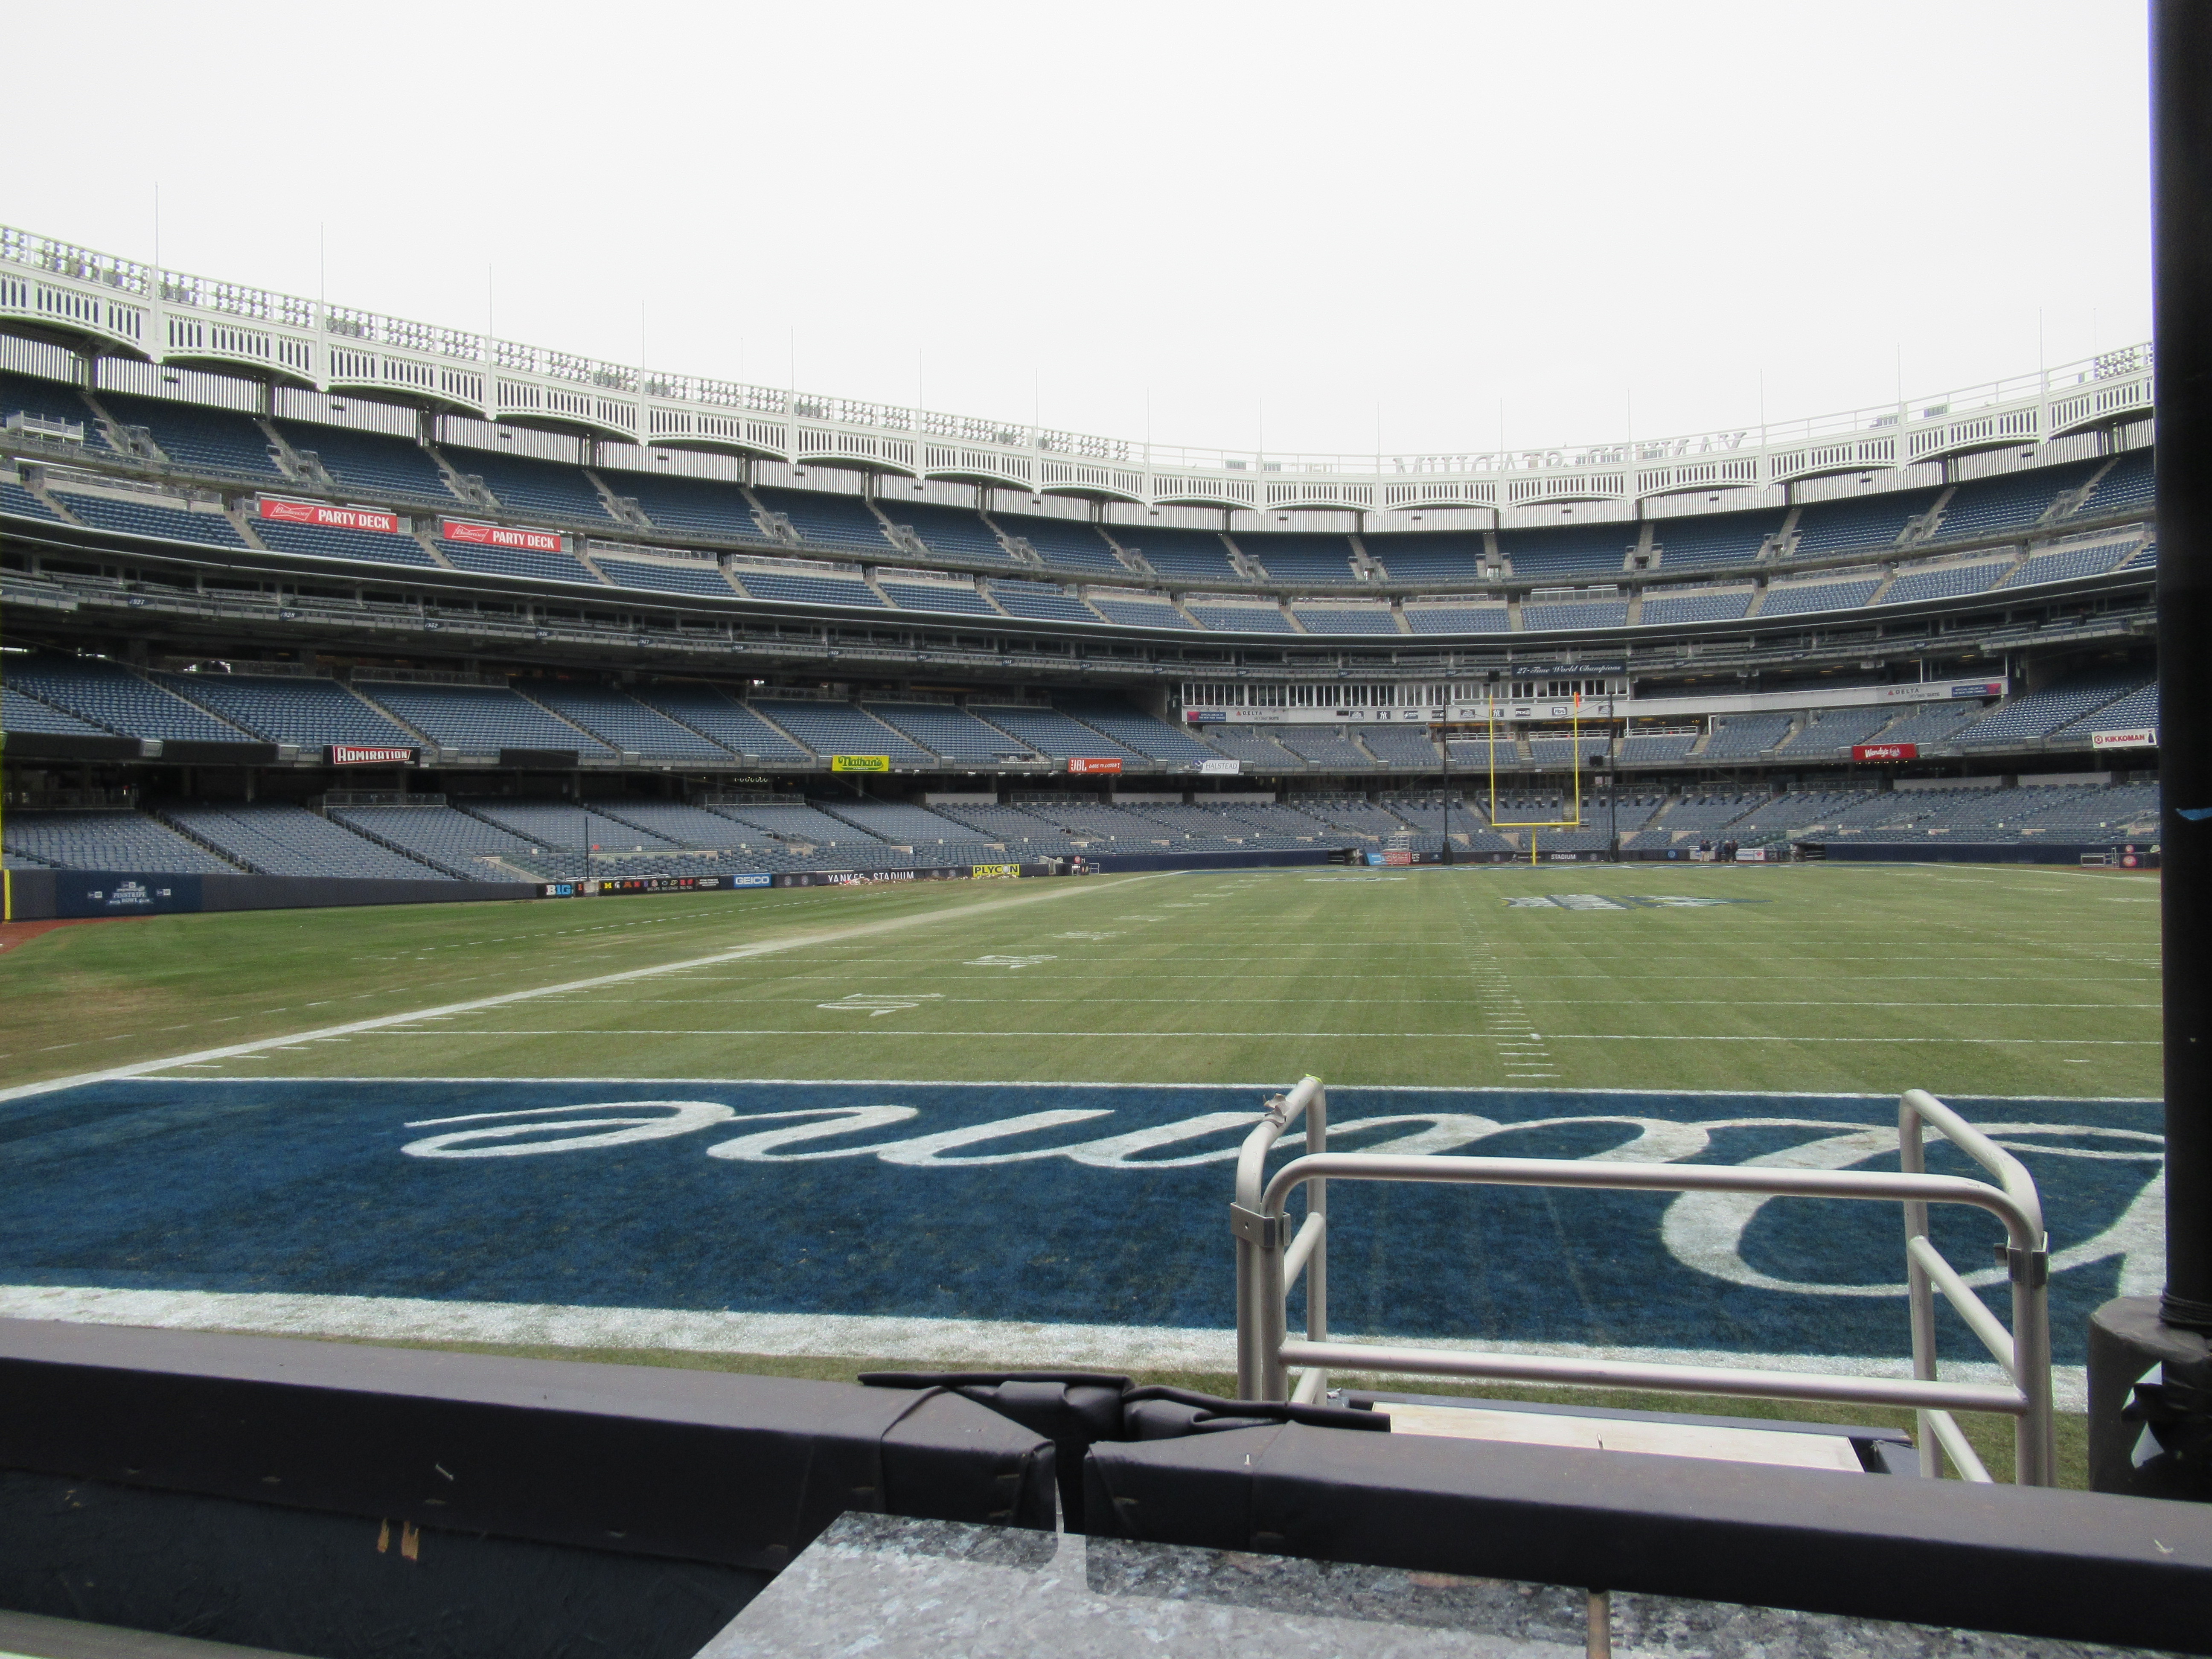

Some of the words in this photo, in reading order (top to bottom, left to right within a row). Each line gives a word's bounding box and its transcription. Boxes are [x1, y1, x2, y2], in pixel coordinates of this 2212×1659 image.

[276, 506, 309, 516] Budweiser
[318, 509, 355, 525] PARTY
[359, 515, 390, 529] DECK
[457, 528, 485, 537] Budweiser
[493, 531, 524, 547] PARTY
[527, 536, 554, 549] DECK
[1579, 665, 1621, 673] Champions
[338, 747, 408, 762] ADMIRATION
[1865, 747, 1889, 757] Wendy's
[838, 755, 882, 767] Nathan's
[1073, 760, 1087, 771] JBL
[735, 876, 770, 885] GEICO
[873, 871, 914, 880] STADIUM
[817, 993, 946, 1009] 10
